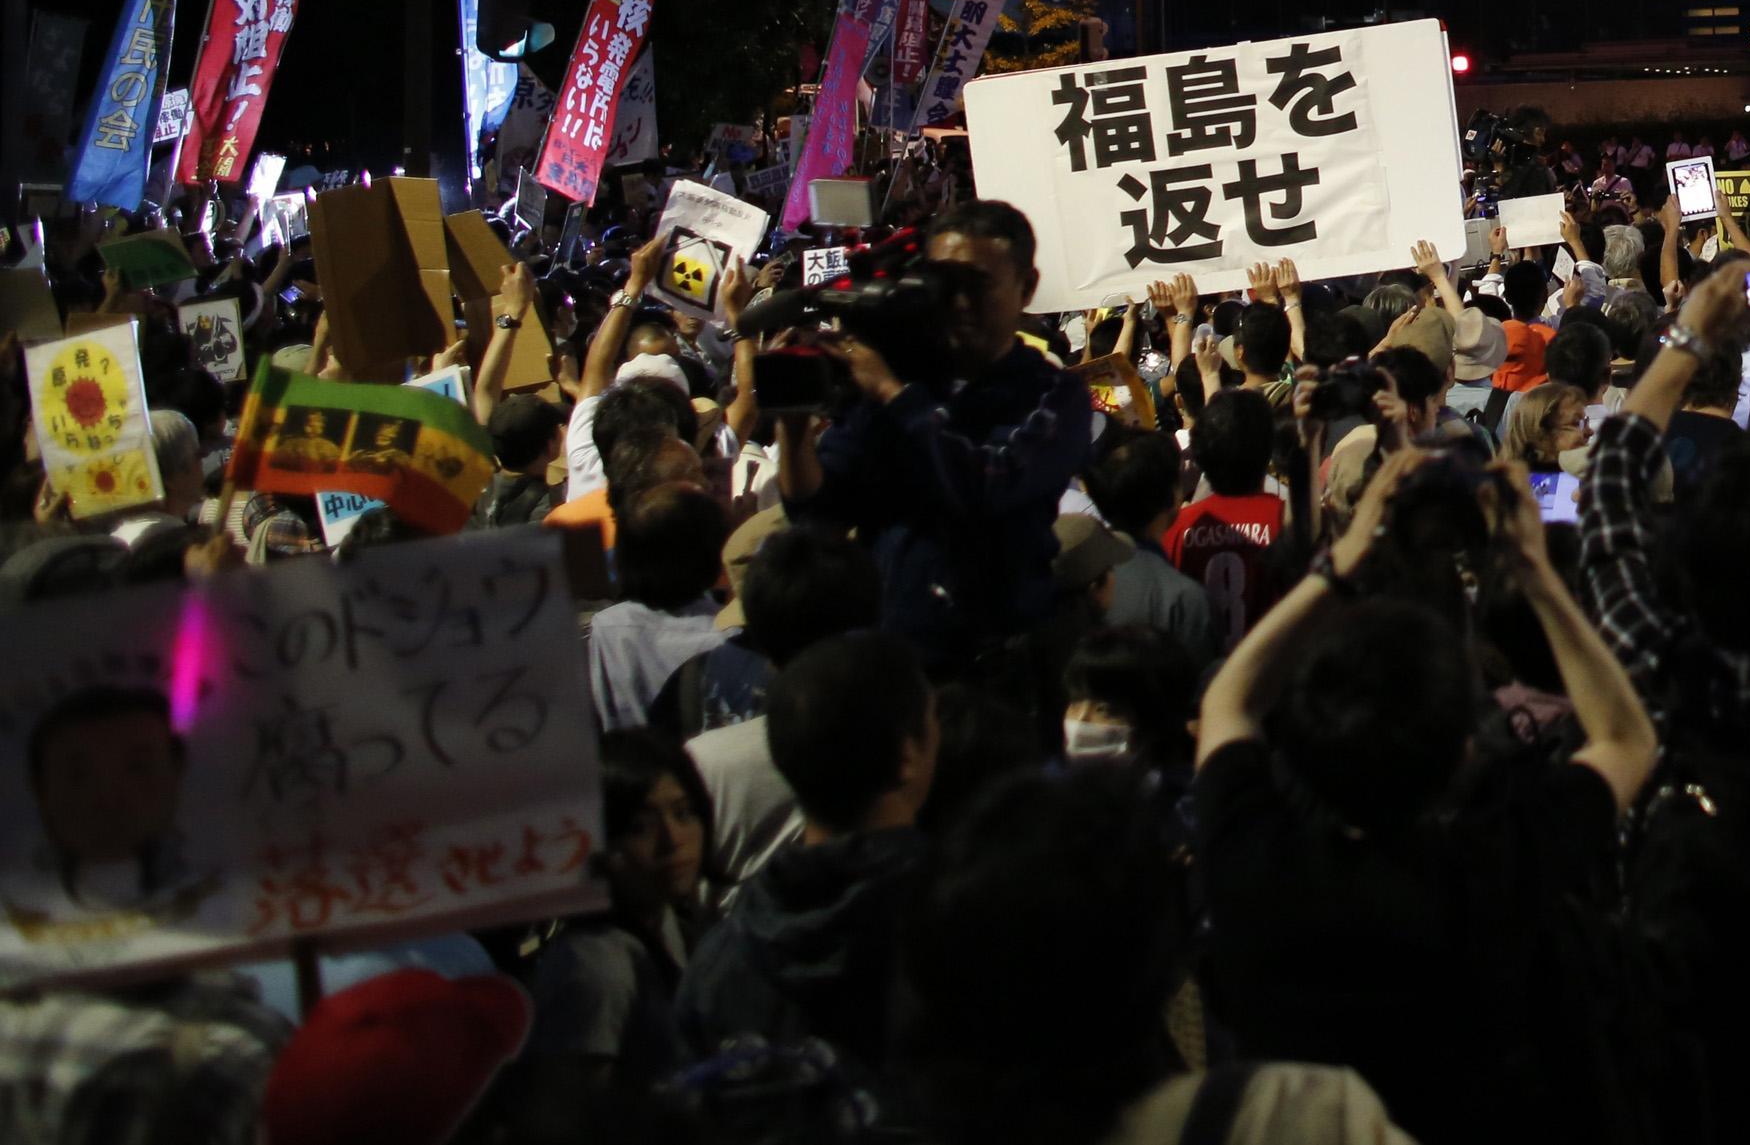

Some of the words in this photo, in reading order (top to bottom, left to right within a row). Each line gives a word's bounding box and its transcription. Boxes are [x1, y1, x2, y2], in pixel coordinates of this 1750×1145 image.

[1052, 42, 1359, 173] 福島を
[1116, 152, 1321, 270] 返せ
[1717, 178, 1735, 195] NO
[1184, 521, 1271, 549] OGASAWARA
